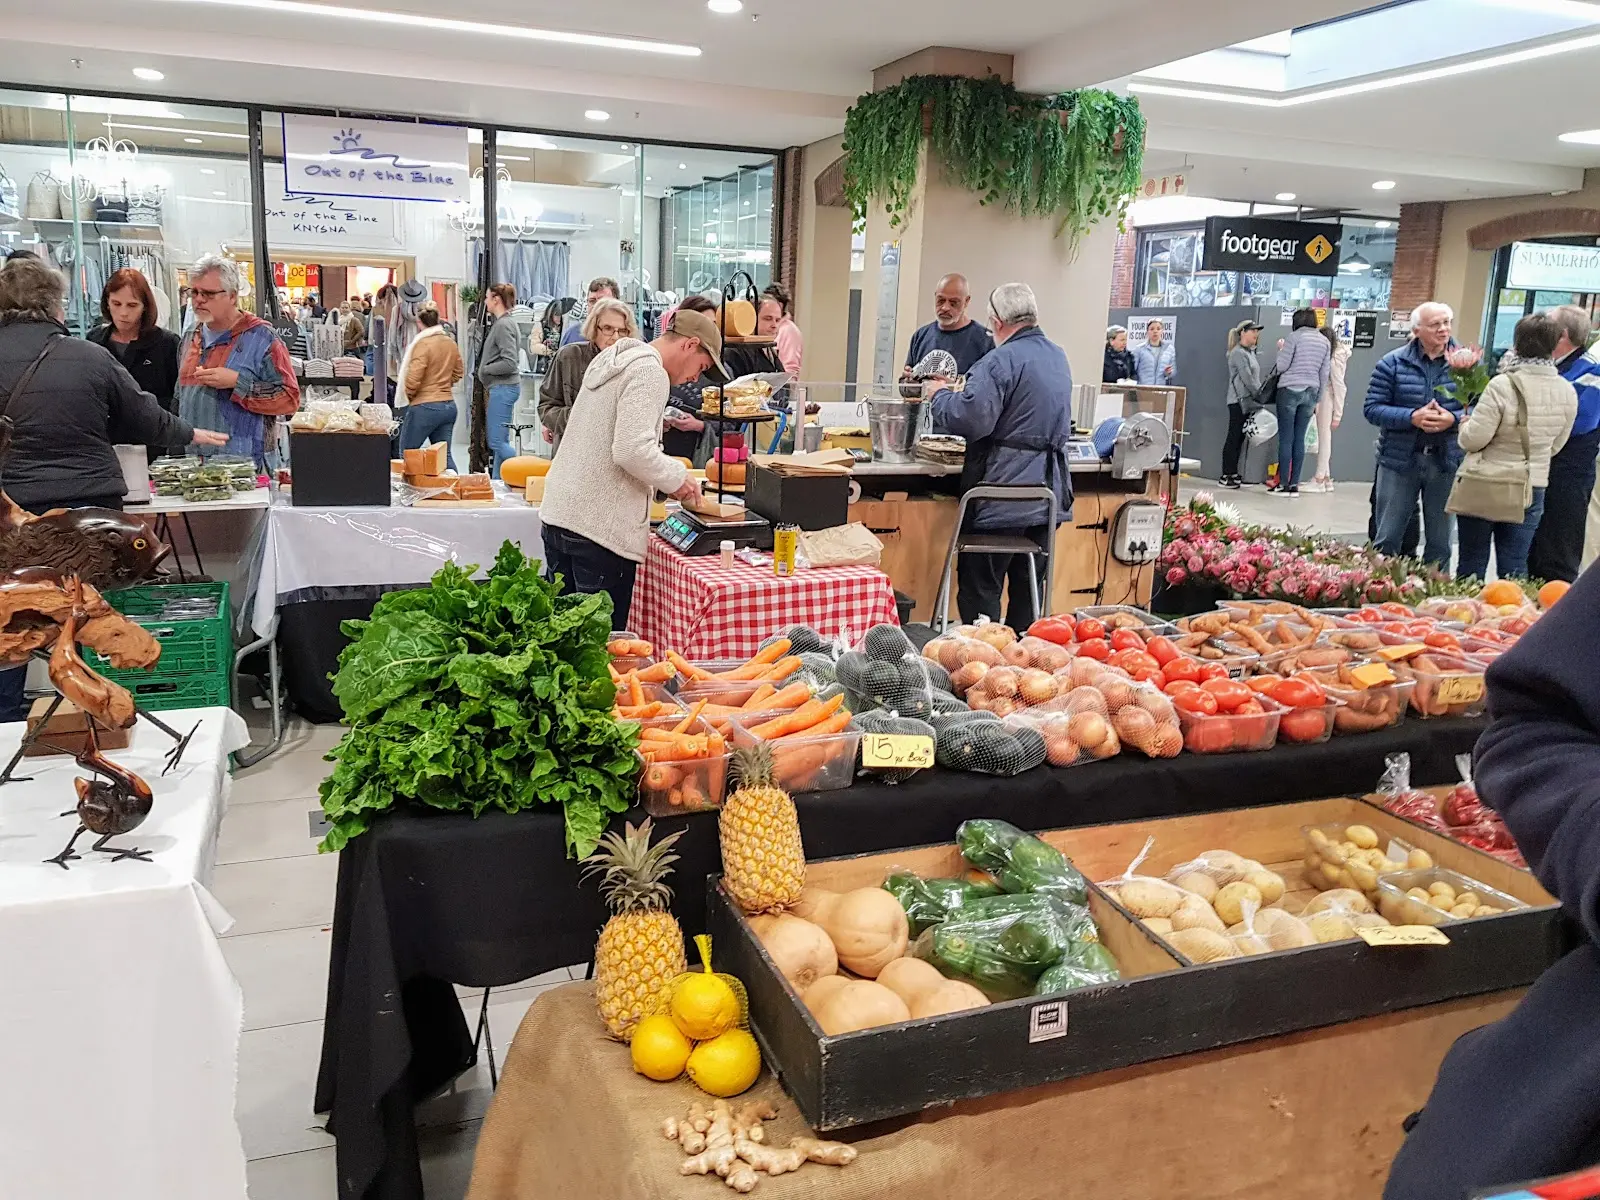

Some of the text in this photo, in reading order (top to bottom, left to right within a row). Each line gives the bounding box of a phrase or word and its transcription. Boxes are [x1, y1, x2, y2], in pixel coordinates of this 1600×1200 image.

[304, 164, 341, 178] Out
[349, 169, 365, 182] of
[374, 171, 405, 182] the
[293, 210, 307, 221] of
[314, 211, 337, 221] the
[293, 223, 348, 234] KNYSNA
[1221, 229, 1300, 260] footgear
[1131, 322, 1145, 331] YOUR
[1129, 332, 1135, 340] IS
[871, 736, 893, 760] 15
